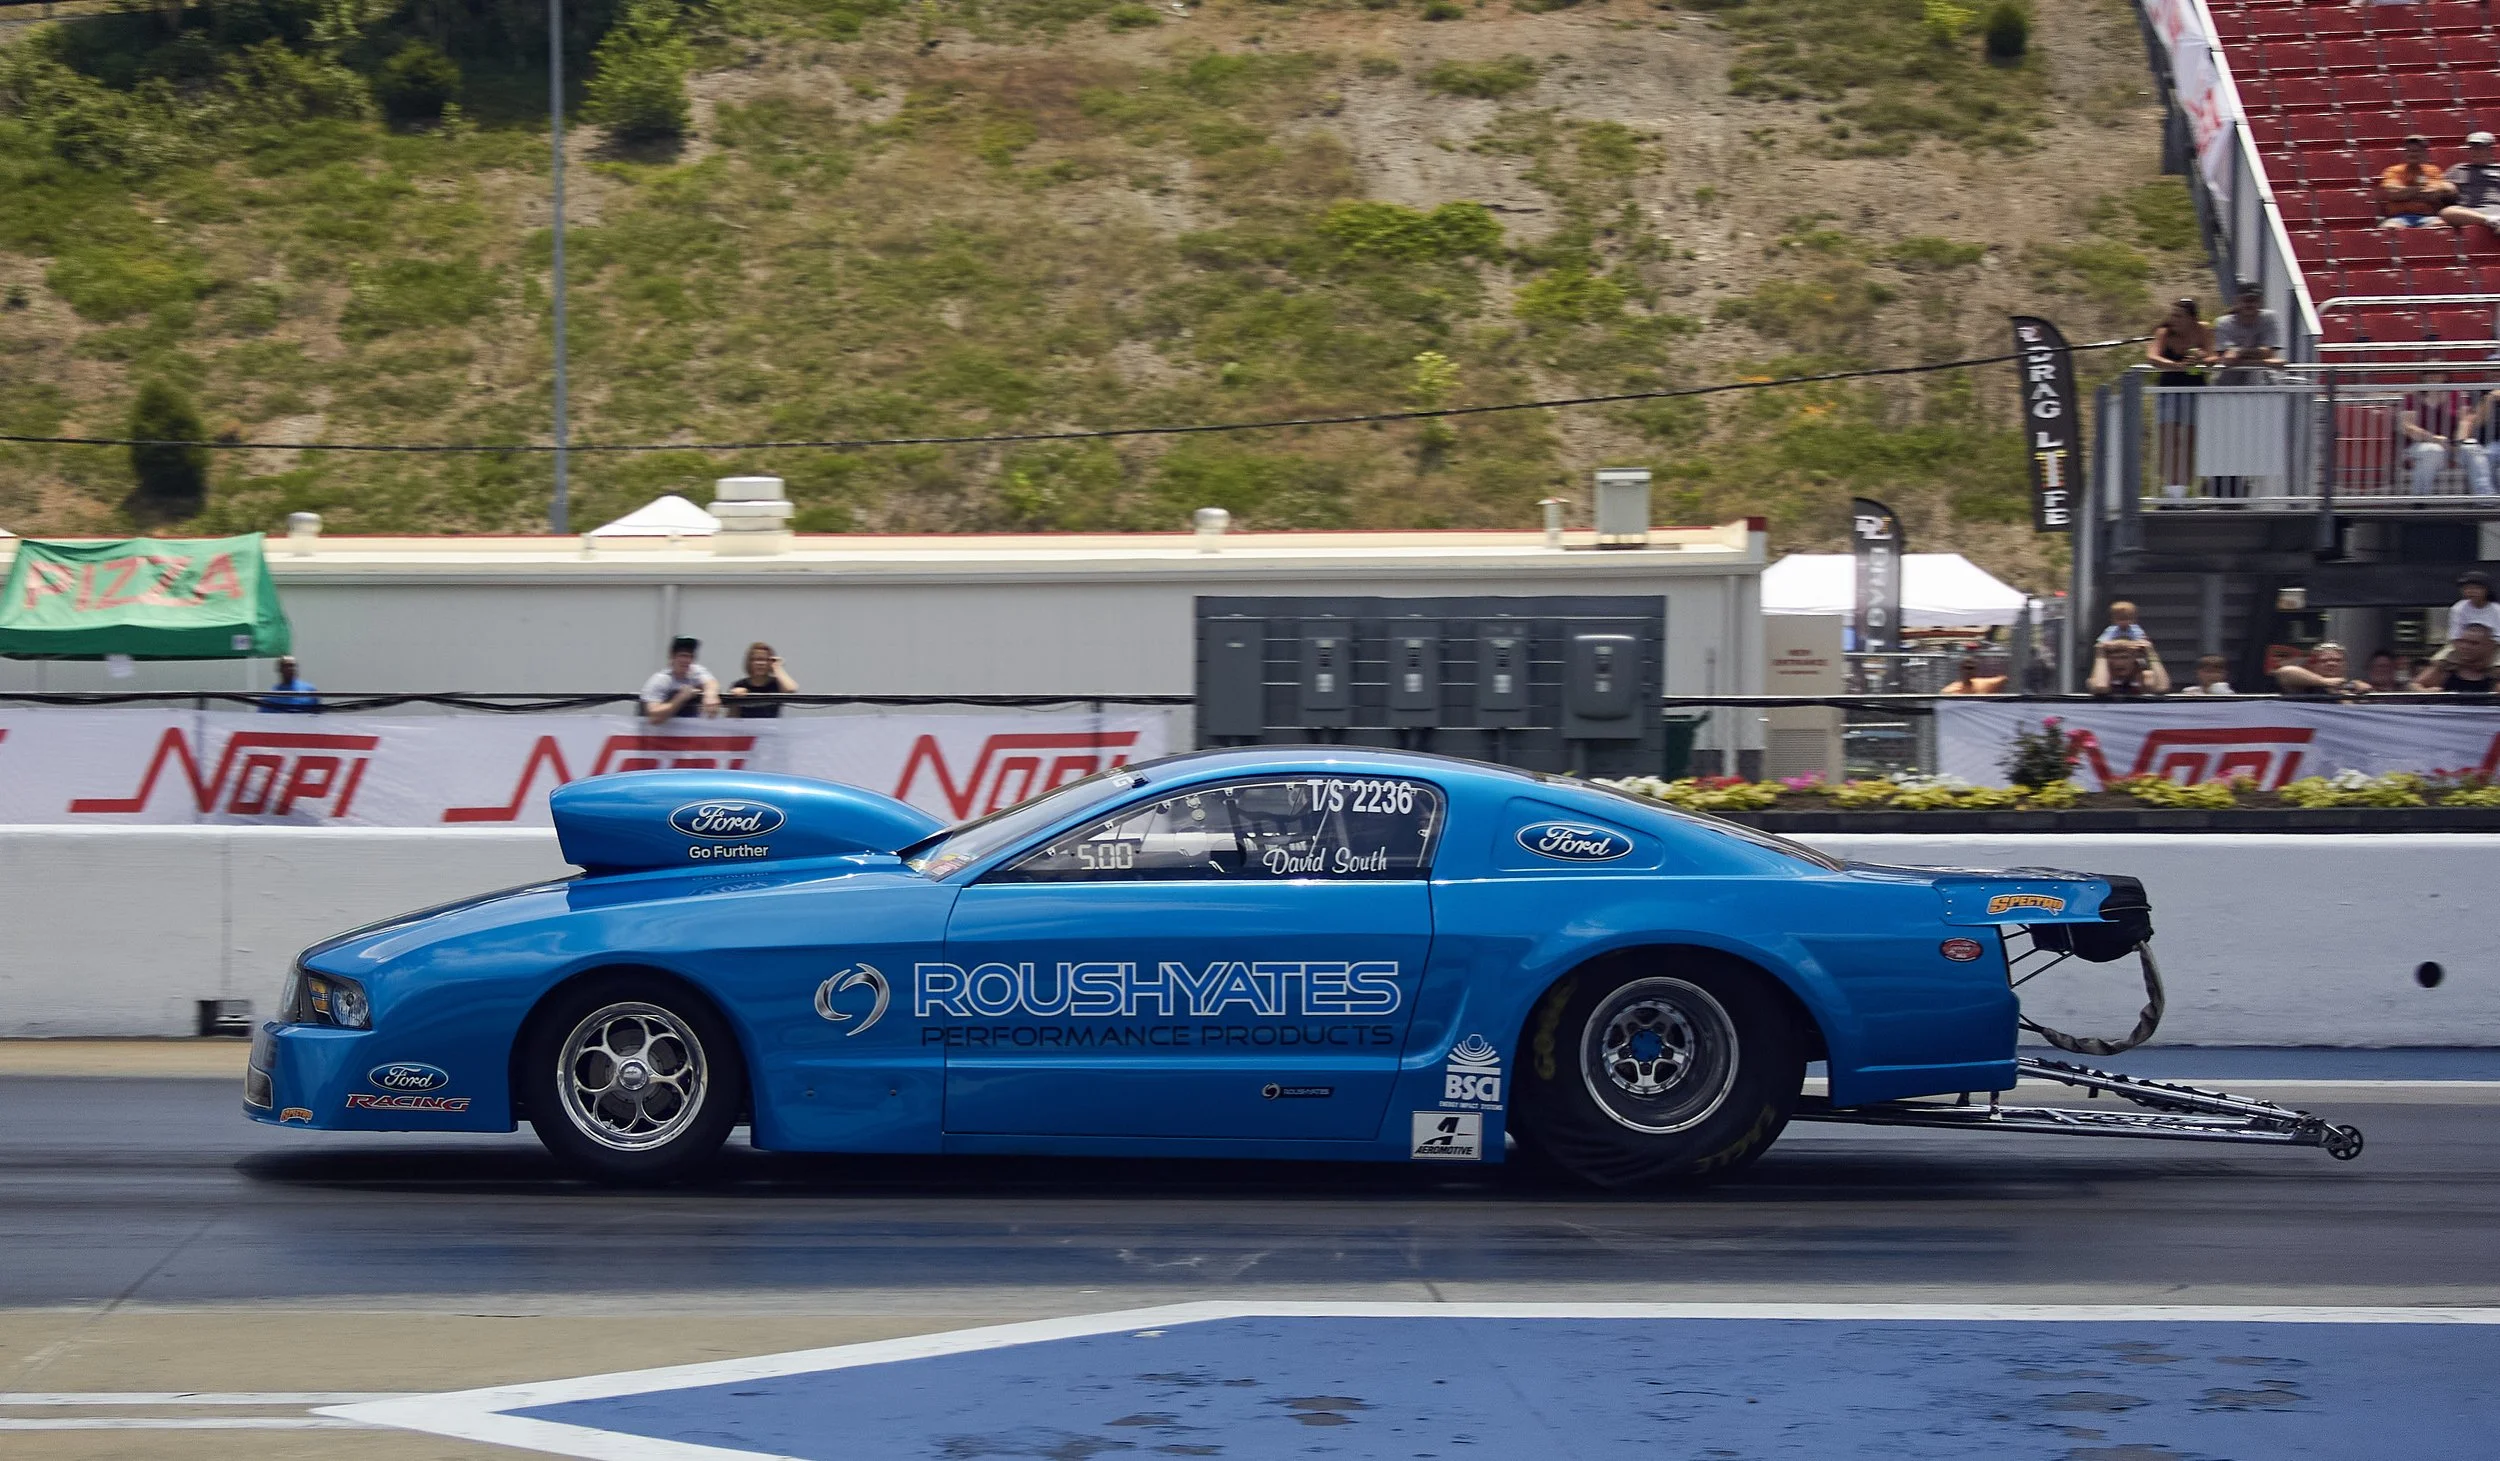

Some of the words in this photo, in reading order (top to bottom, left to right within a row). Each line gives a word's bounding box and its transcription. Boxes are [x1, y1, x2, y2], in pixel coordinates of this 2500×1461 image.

[2026, 345, 2063, 419] DRAG
[24, 553, 244, 612] PIZZA
[67, 727, 381, 818] NOPI
[892, 731, 1140, 821] NOP
[1307, 779, 1345, 812] T/S
[1352, 780, 1414, 815] 2236
[691, 804, 763, 832] Ford
[689, 846, 711, 859] Go
[714, 844, 769, 858] Further
[1539, 826, 1612, 856] Ford
[1077, 842, 1134, 870] 5.00
[1262, 847, 1327, 875] David
[1331, 846, 1388, 874] South
[914, 961, 1401, 1018] ROUSHYATES
[921, 1026, 1191, 1047] PERFORMANCE
[1201, 1025, 1395, 1046] PRODUCTS
[384, 1066, 434, 1089] Ford
[1445, 1074, 1501, 1102] BSCI
[346, 1094, 472, 1112] RACING
[1415, 1146, 1474, 1156] AEROMOTIVE
